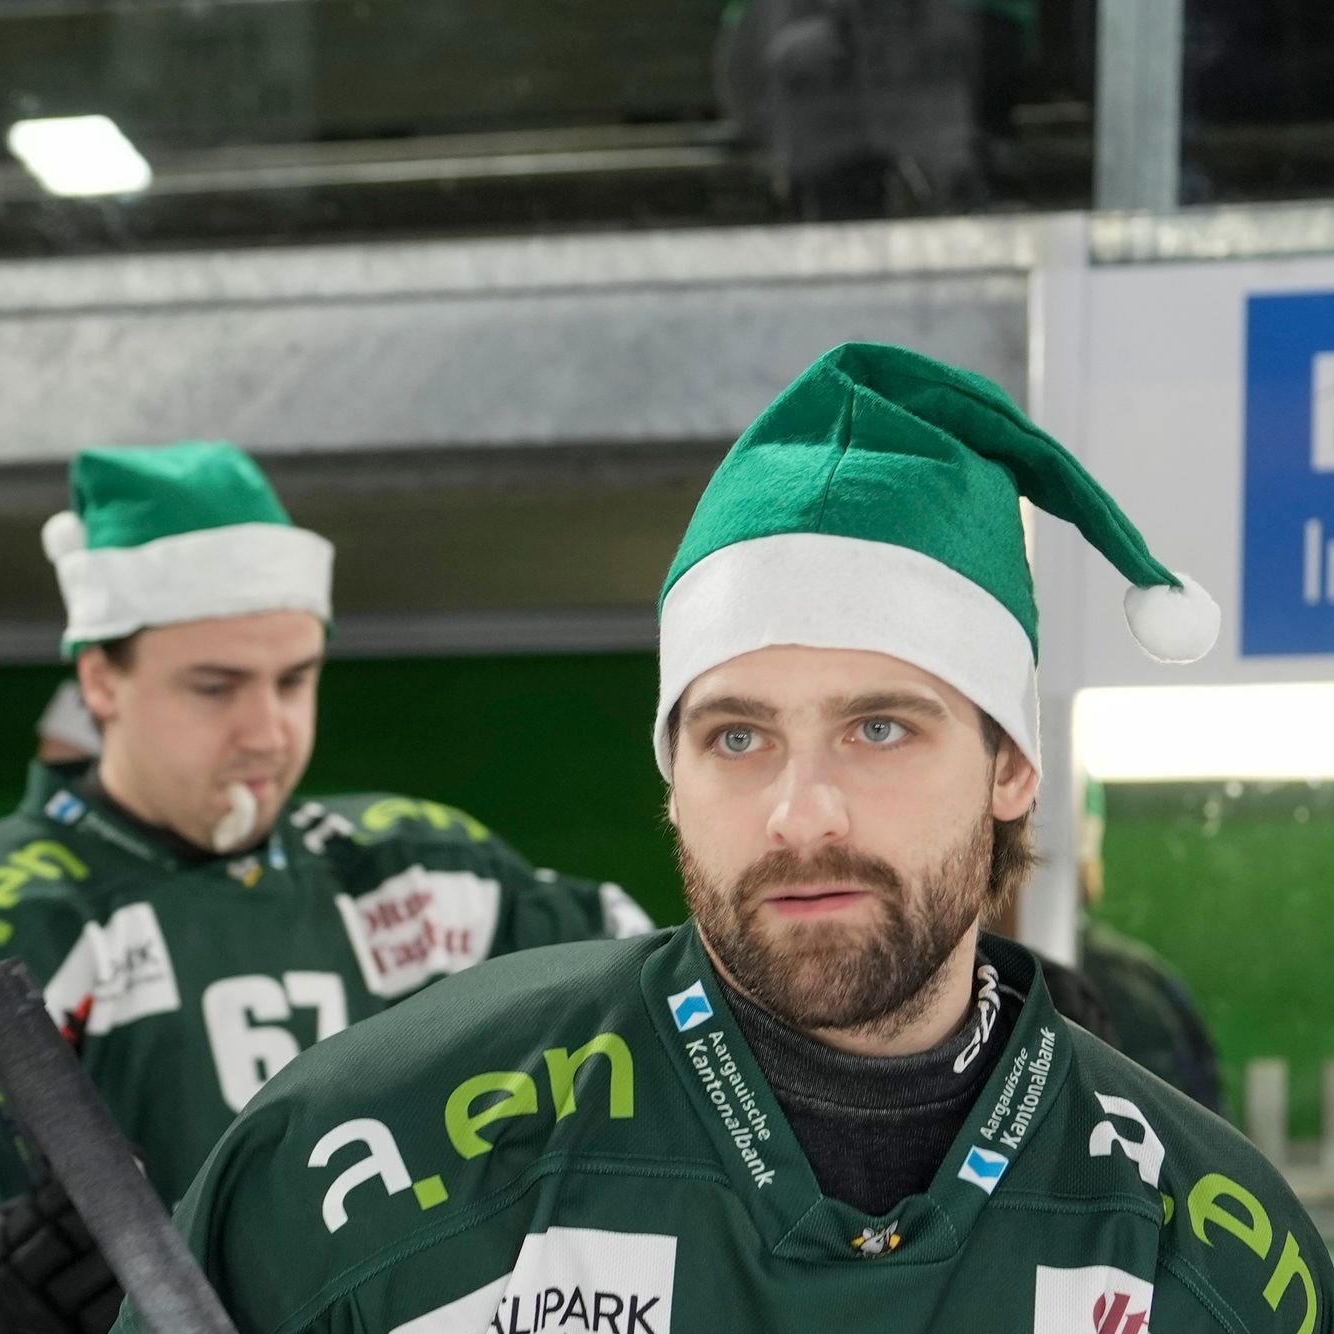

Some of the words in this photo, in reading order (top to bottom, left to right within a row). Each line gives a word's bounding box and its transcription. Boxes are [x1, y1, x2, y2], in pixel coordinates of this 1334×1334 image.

[307, 1031, 634, 1234] a.en
[685, 1038, 775, 1190] Kantonalbank
[708, 1030, 771, 1141] Aargauische
[980, 1047, 1028, 1141] Aargauische
[999, 1025, 1056, 1149] Kantonalbank
